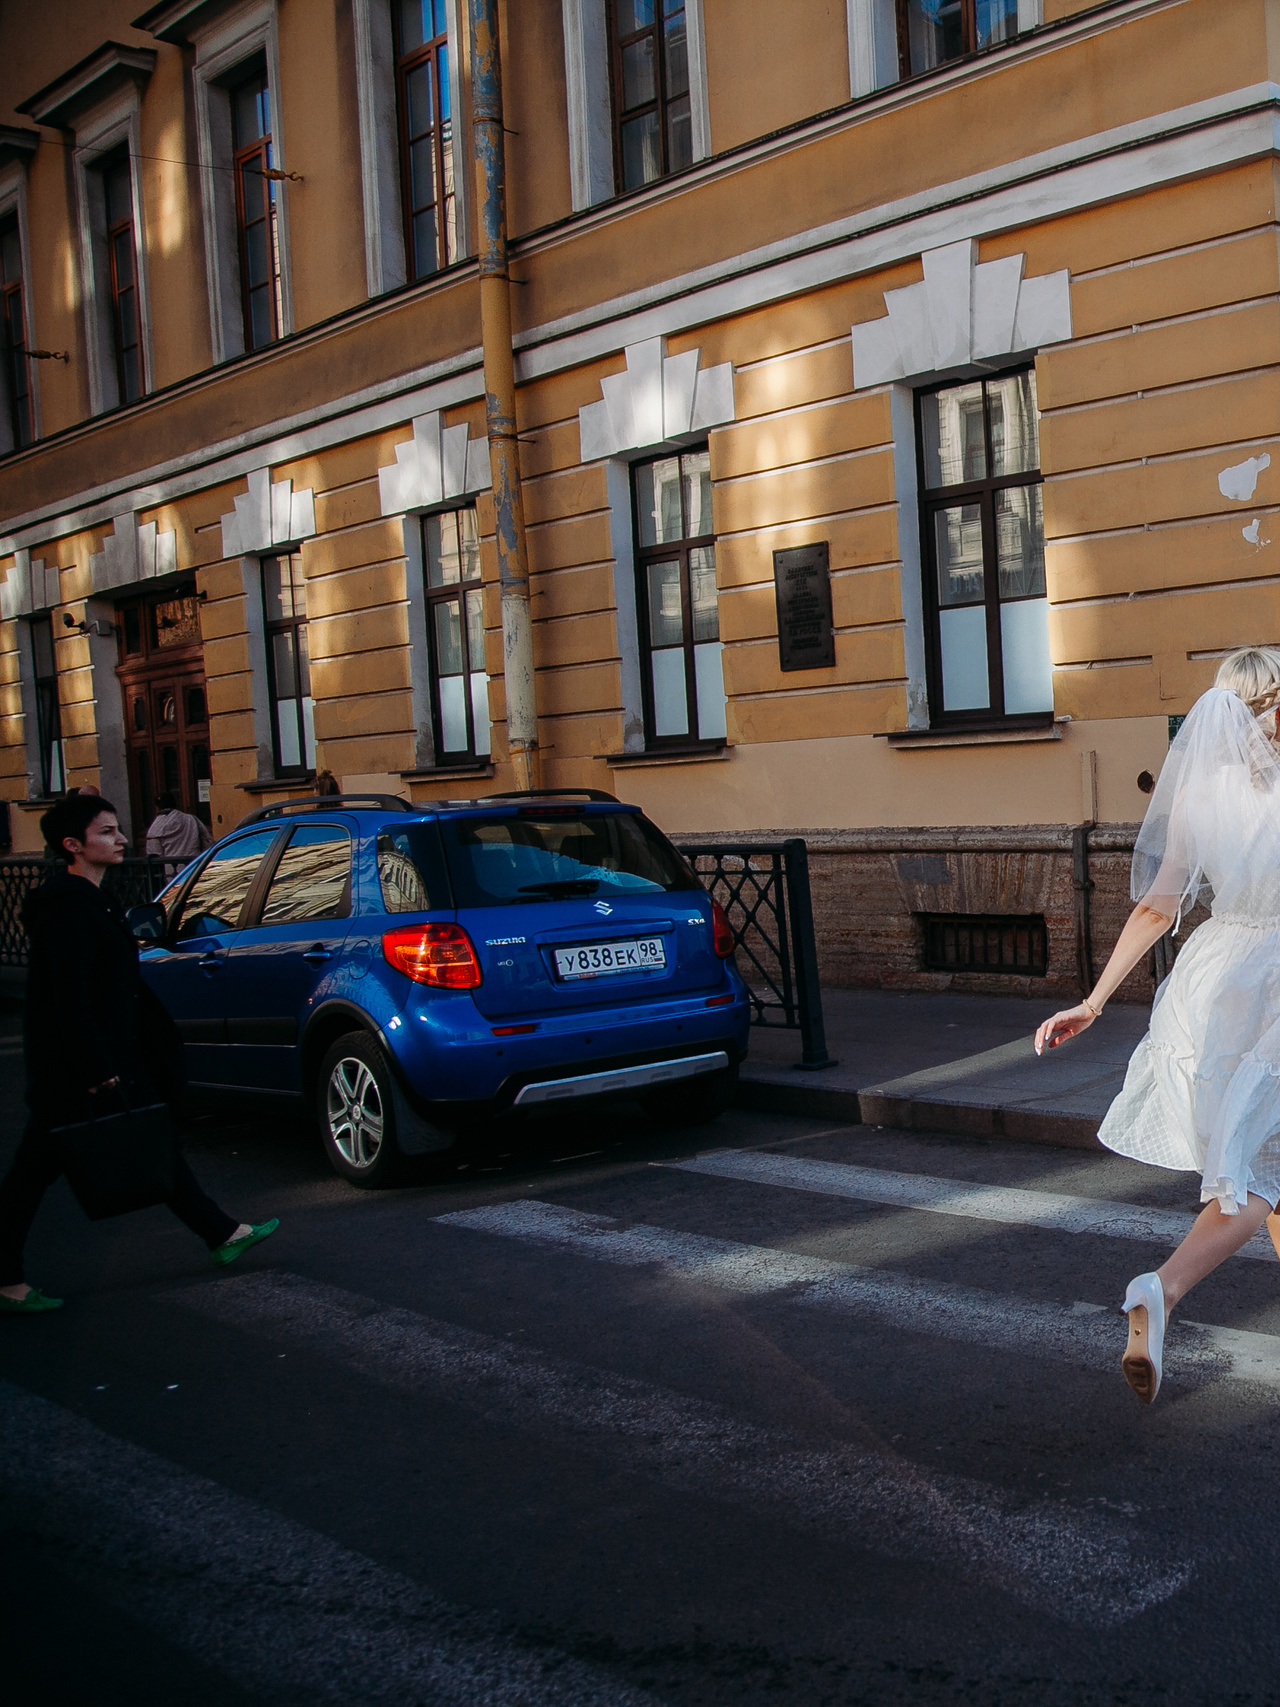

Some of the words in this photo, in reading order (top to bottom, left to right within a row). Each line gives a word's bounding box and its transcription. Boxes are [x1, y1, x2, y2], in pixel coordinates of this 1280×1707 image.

[565, 947, 637, 972] У838ЕК
[640, 942, 657, 958] 98
[641, 956, 654, 964] RUS
